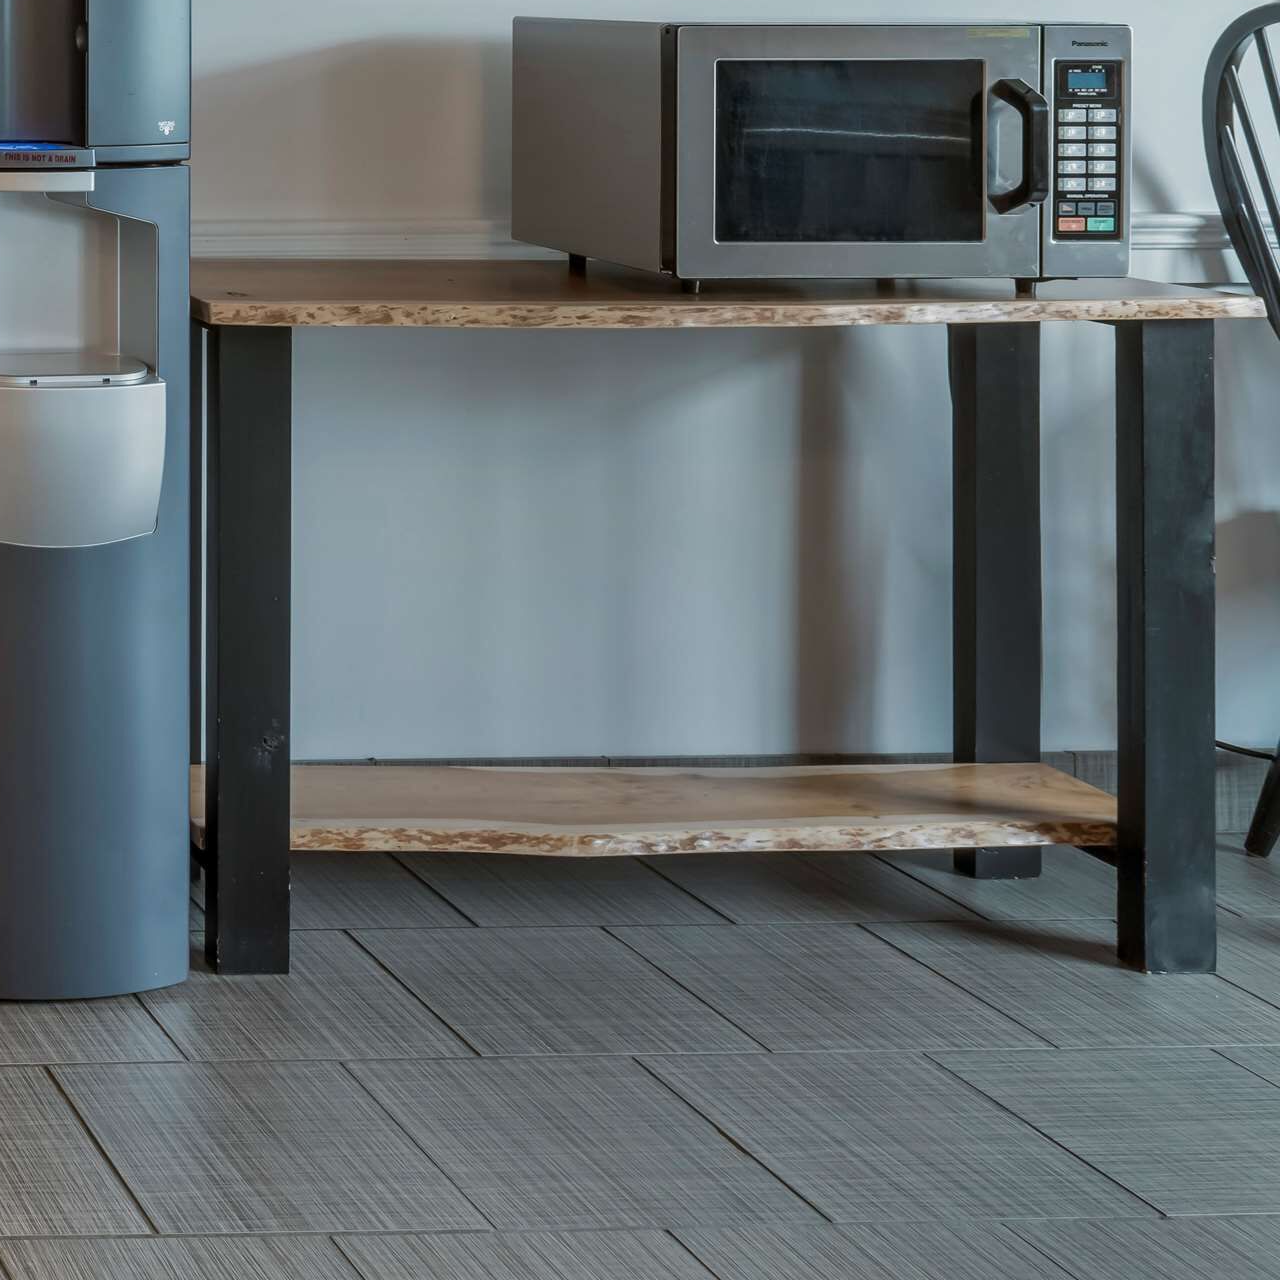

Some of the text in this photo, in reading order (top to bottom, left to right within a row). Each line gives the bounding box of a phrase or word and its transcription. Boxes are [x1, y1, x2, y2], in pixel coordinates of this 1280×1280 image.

[1071, 40, 1109, 48] Panasonic
[4, 152, 77, 163] THIS IS NOT A DRAIN
